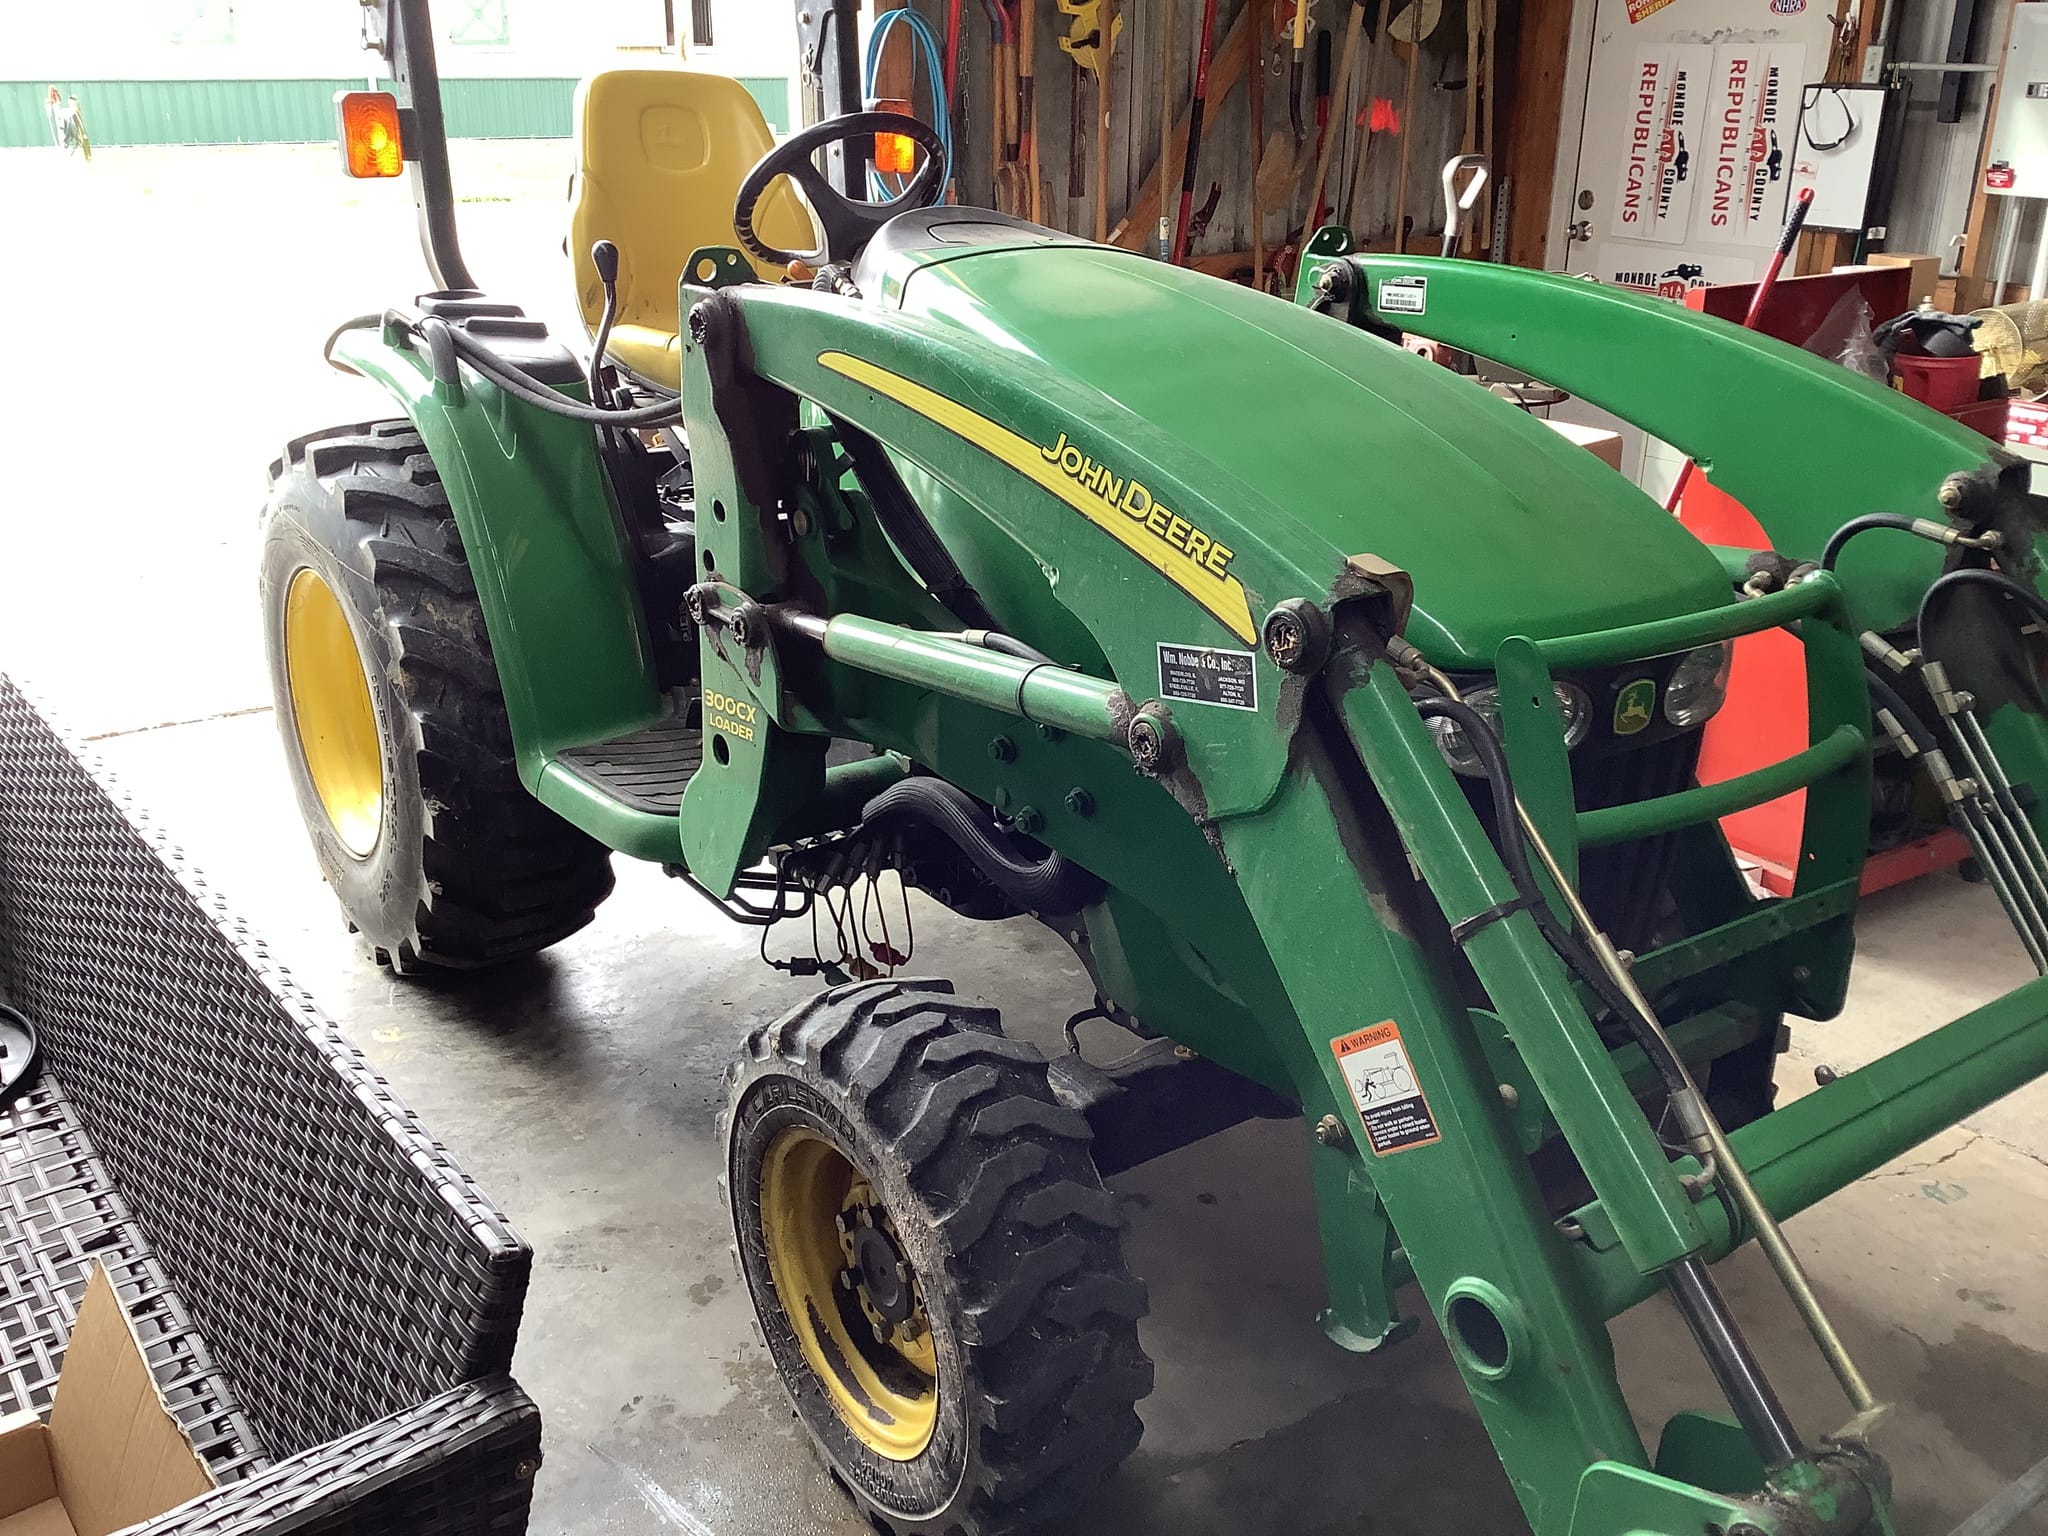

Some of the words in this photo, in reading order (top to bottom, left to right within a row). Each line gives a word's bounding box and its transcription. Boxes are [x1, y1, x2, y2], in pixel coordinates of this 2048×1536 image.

[1775, 0, 1802, 12] NHRA
[1671, 71, 1687, 126] MONROE
[1763, 67, 1779, 125] MONROE
[1622, 62, 1659, 224] REPUBLICANS
[1711, 59, 1748, 227] REPUBLICANS
[1657, 168, 1677, 219] COUNTY
[1748, 168, 1770, 222] COUNTY
[1615, 272, 1658, 287] MONROE
[1041, 432, 1124, 504] JOHN
[1119, 479, 1235, 580] DEERE
[705, 688, 757, 724] 300CX
[709, 712, 754, 742] LOADER
[1351, 1027, 1391, 1047] WARNING
